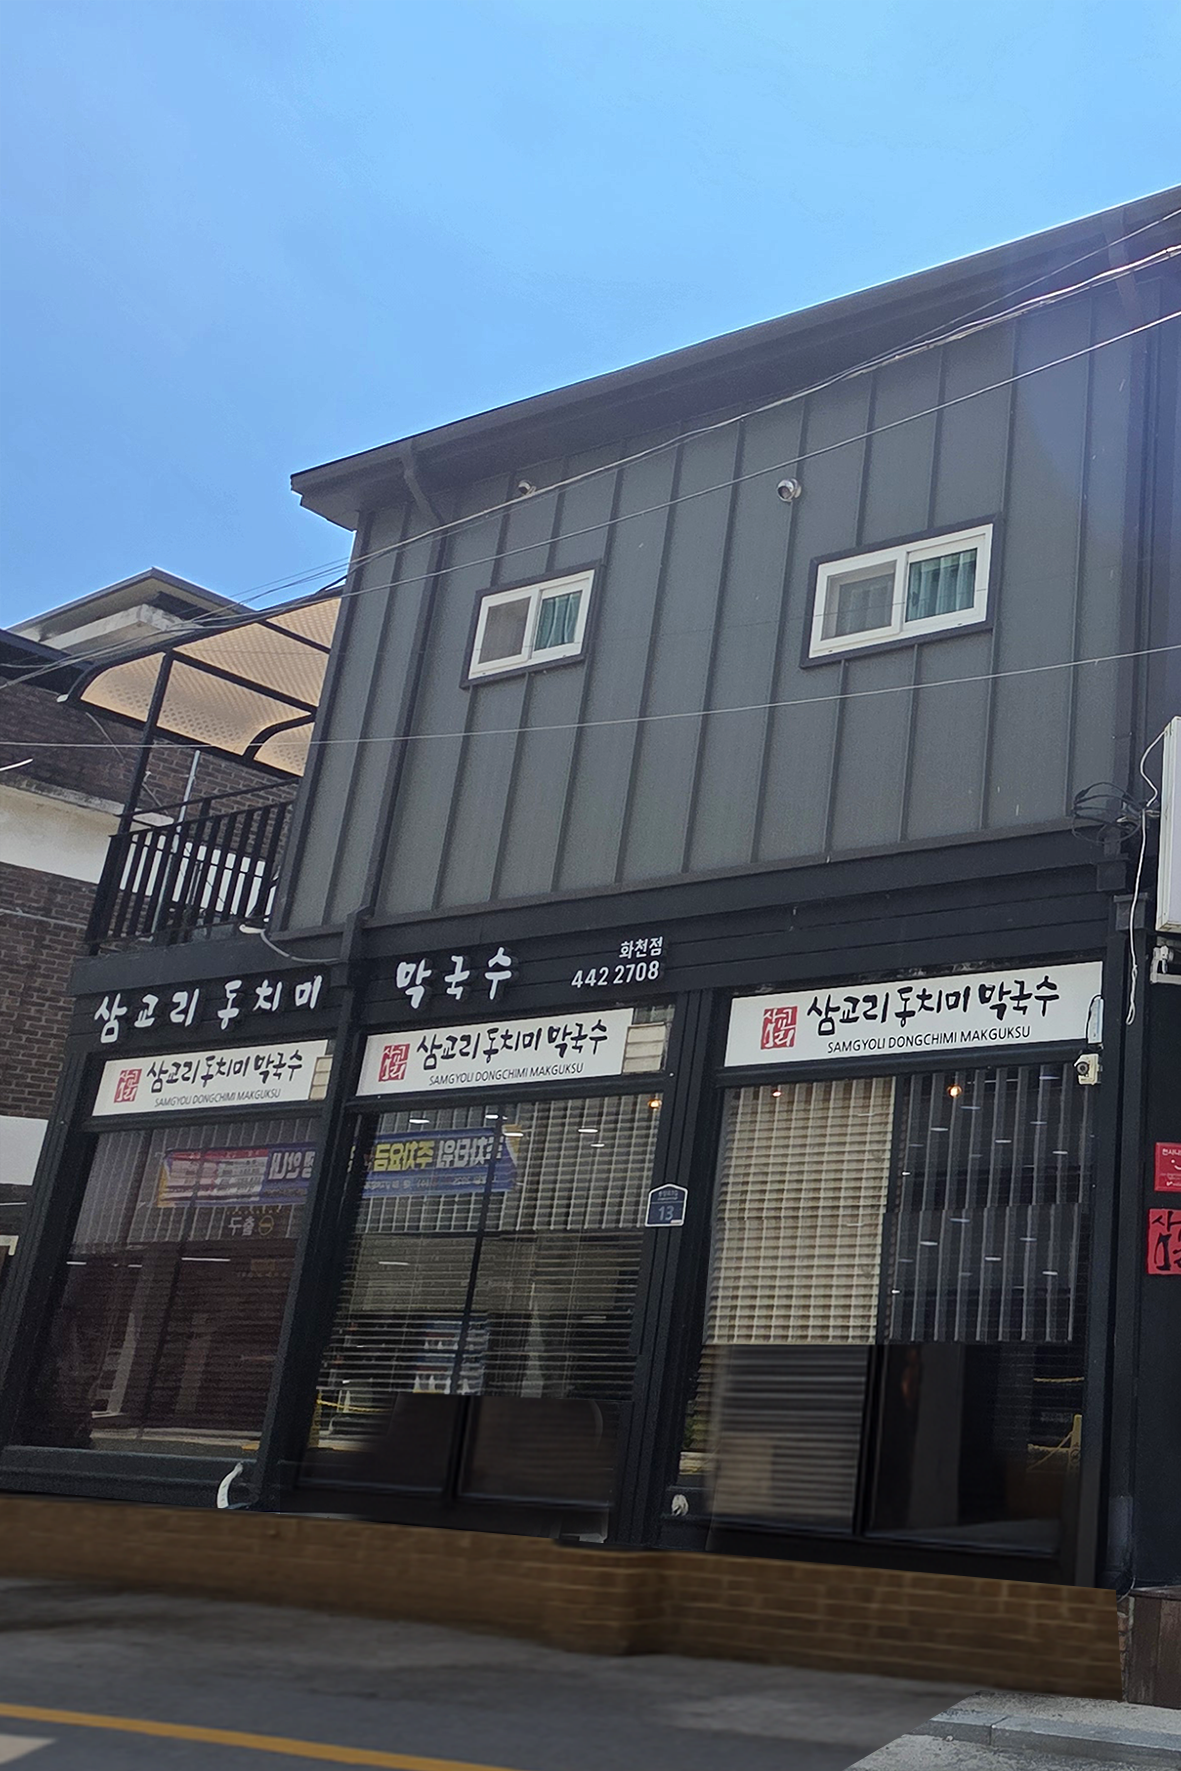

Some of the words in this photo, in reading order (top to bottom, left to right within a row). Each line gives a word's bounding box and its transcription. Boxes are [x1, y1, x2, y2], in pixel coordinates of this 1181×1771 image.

[619, 936, 665, 959] 화천점
[571, 966, 609, 989] 442
[613, 960, 661, 986] 2708
[94, 987, 200, 1044] 삼교리
[217, 974, 323, 1030] 동치미
[395, 946, 513, 1010] 막국수
[806, 992, 891, 1037] 삼교리
[895, 985, 971, 1029] 동치미
[978, 975, 1061, 1022] 막국수
[416, 1032, 481, 1071] 삼교리
[482, 1026, 543, 1064] 동치미
[547, 1019, 608, 1059] 막국수
[888, 1029, 958, 1050] DONGCHIMI
[961, 1024, 1032, 1045] MAKGUKSU
[475, 1066, 529, 1082] DONGCHIMI
[530, 1062, 585, 1078] MAKGUKSU
[658, 1205, 675, 1221] 13
